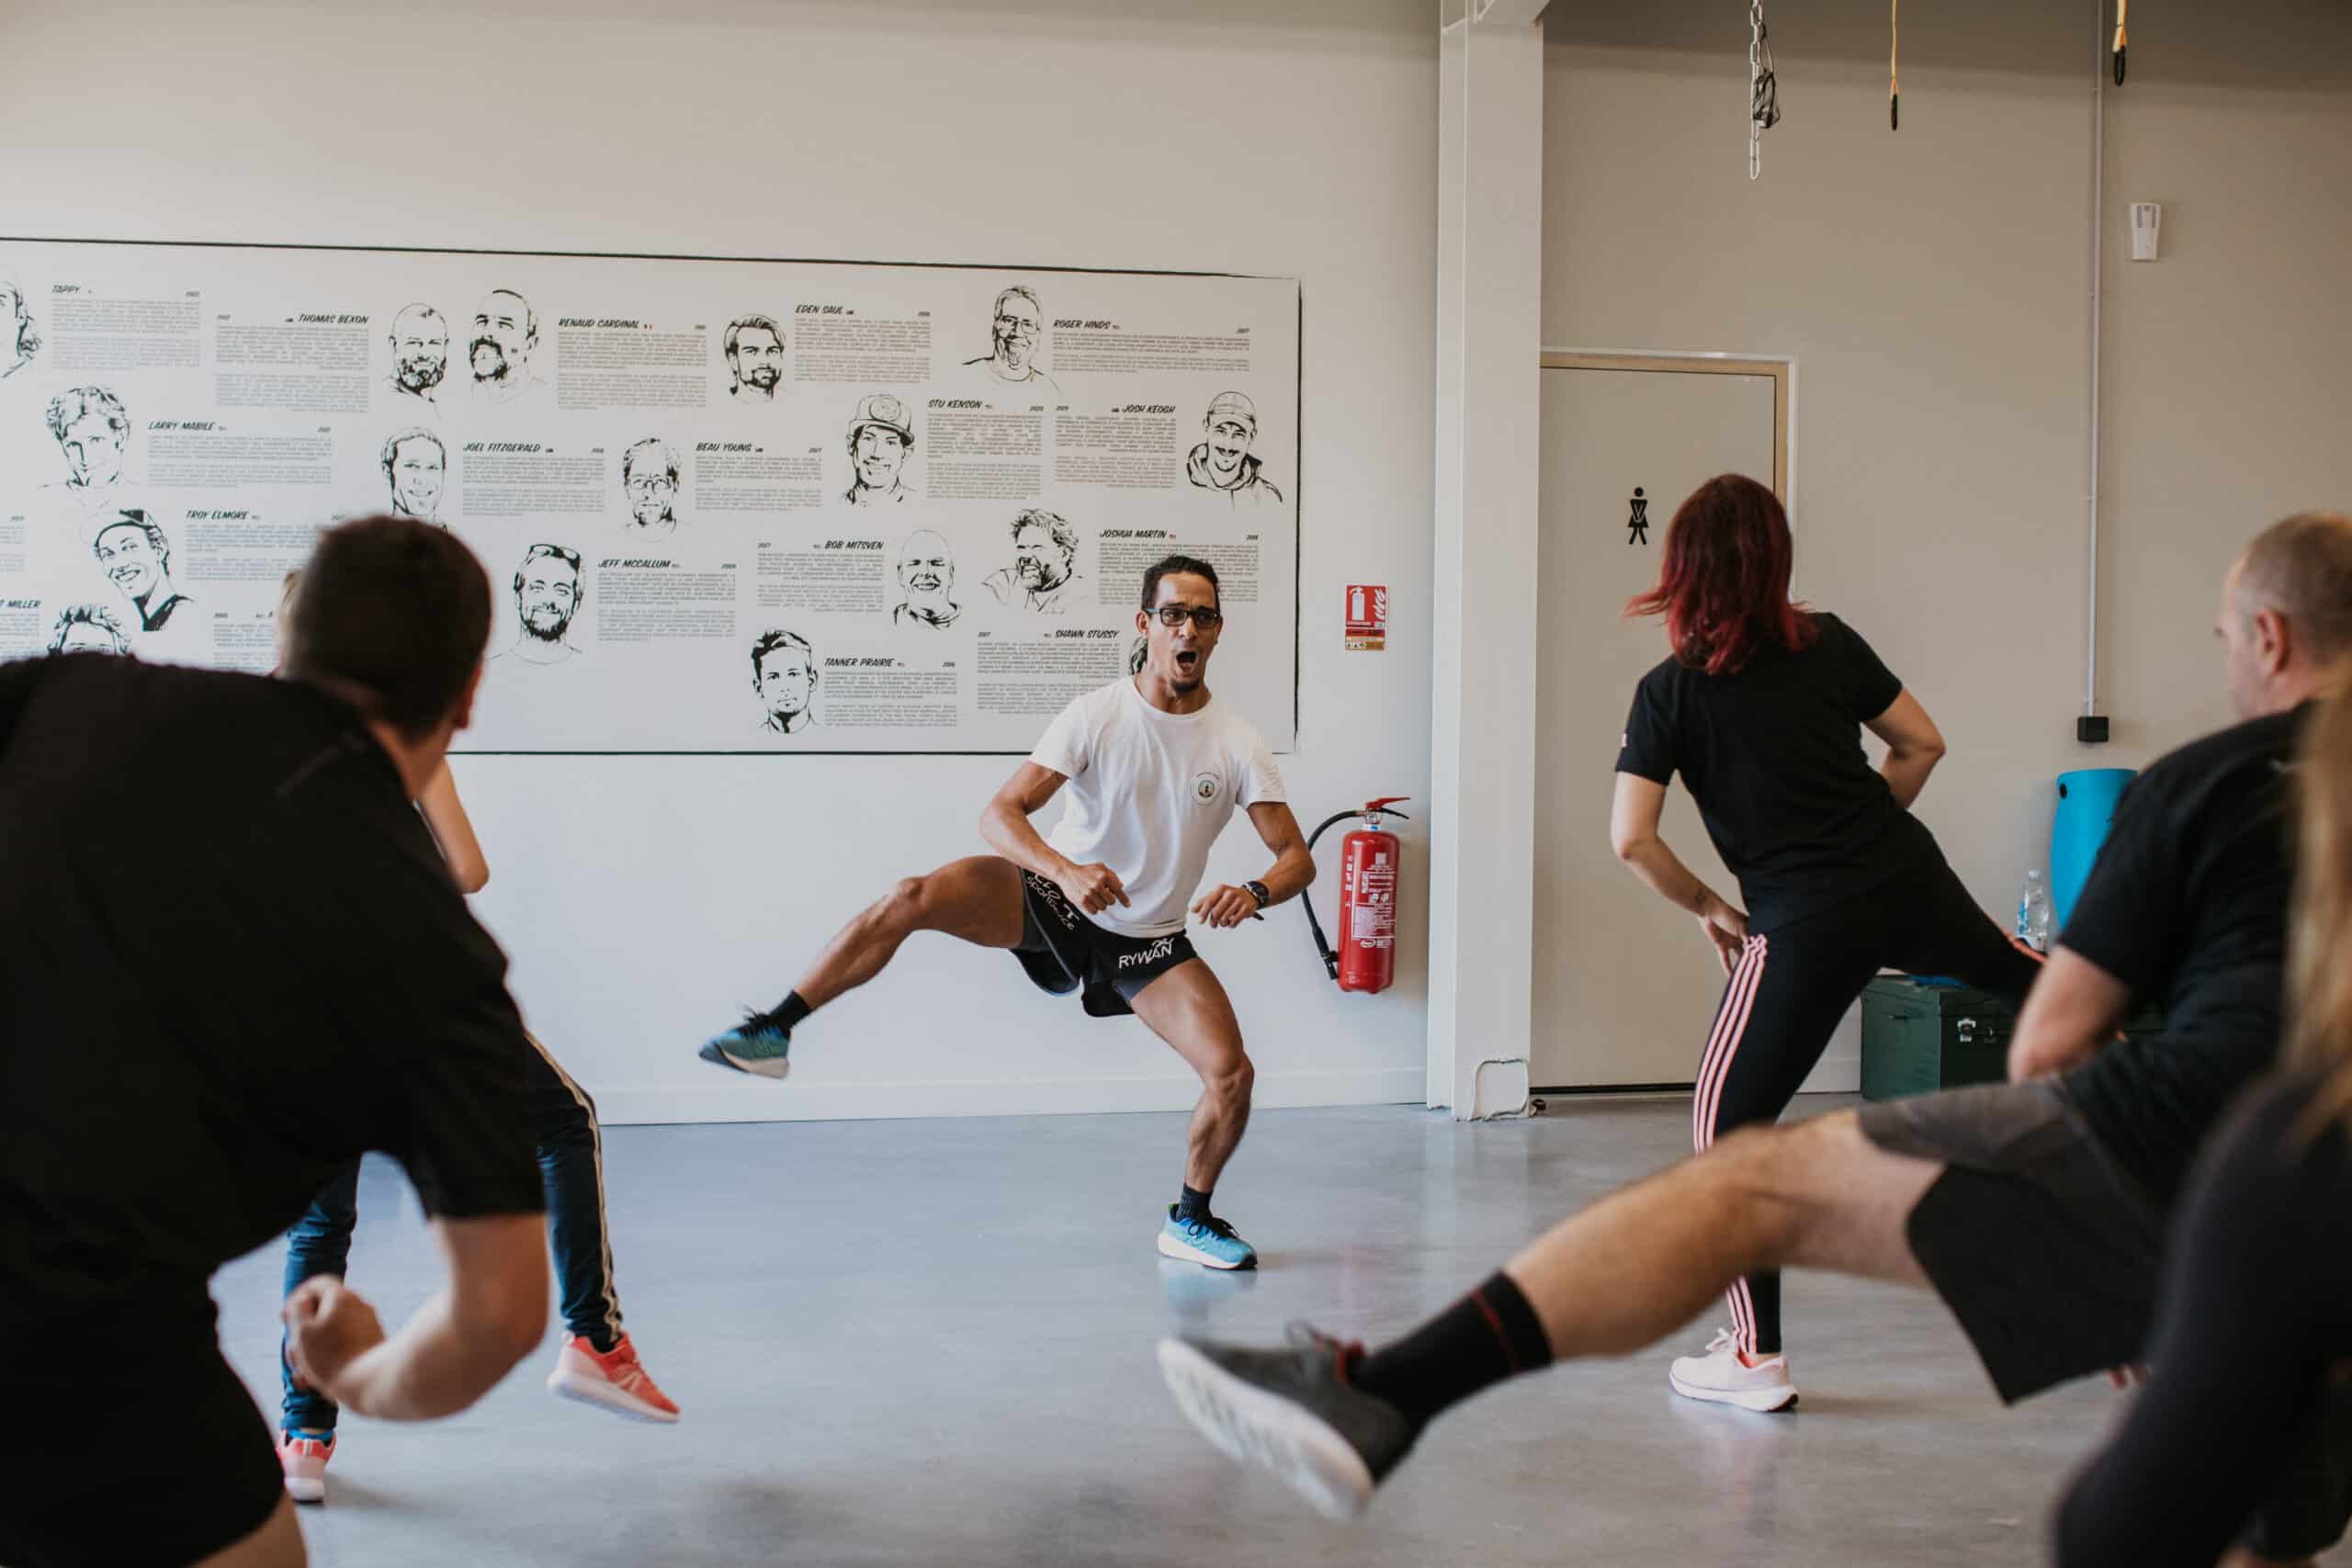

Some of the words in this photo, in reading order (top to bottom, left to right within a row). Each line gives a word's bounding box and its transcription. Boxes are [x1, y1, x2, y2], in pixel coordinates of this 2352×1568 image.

[795, 304, 820, 314] EDEN
[299, 313, 336, 323] THOMAS
[337, 315, 369, 324] BEXON
[558, 318, 594, 327] RENAUD
[597, 319, 639, 329] CARDINAL
[1053, 319, 1083, 329] ROGER
[1084, 321, 1111, 330] HINDS
[928, 399, 945, 409] STU
[947, 400, 982, 410] KENSON
[1122, 404, 1146, 413] JOSH
[1147, 404, 1176, 414] KEOGH
[148, 421, 178, 430] LARRY
[462, 442, 485, 452] JOEL
[487, 443, 541, 453] FITZGERALD
[695, 442, 719, 452] BEAU
[722, 443, 752, 452] YOUNG
[186, 510, 210, 520] TROY
[211, 510, 250, 520] ELMORE
[1099, 529, 1133, 539] JOSHUA
[1134, 529, 1168, 539] MARTIN
[844, 540, 884, 550] MITSVEN
[597, 559, 621, 569] JEFF
[622, 559, 672, 569] MCCALLUM
[7, 599, 41, 608] MILLER
[1055, 629, 1085, 639] SHAWN
[1086, 630, 1119, 639] STUSSY
[825, 658, 859, 668] TANNER
[859, 658, 896, 668] PRAIRIE
[1118, 938, 1174, 970] RYWAN
